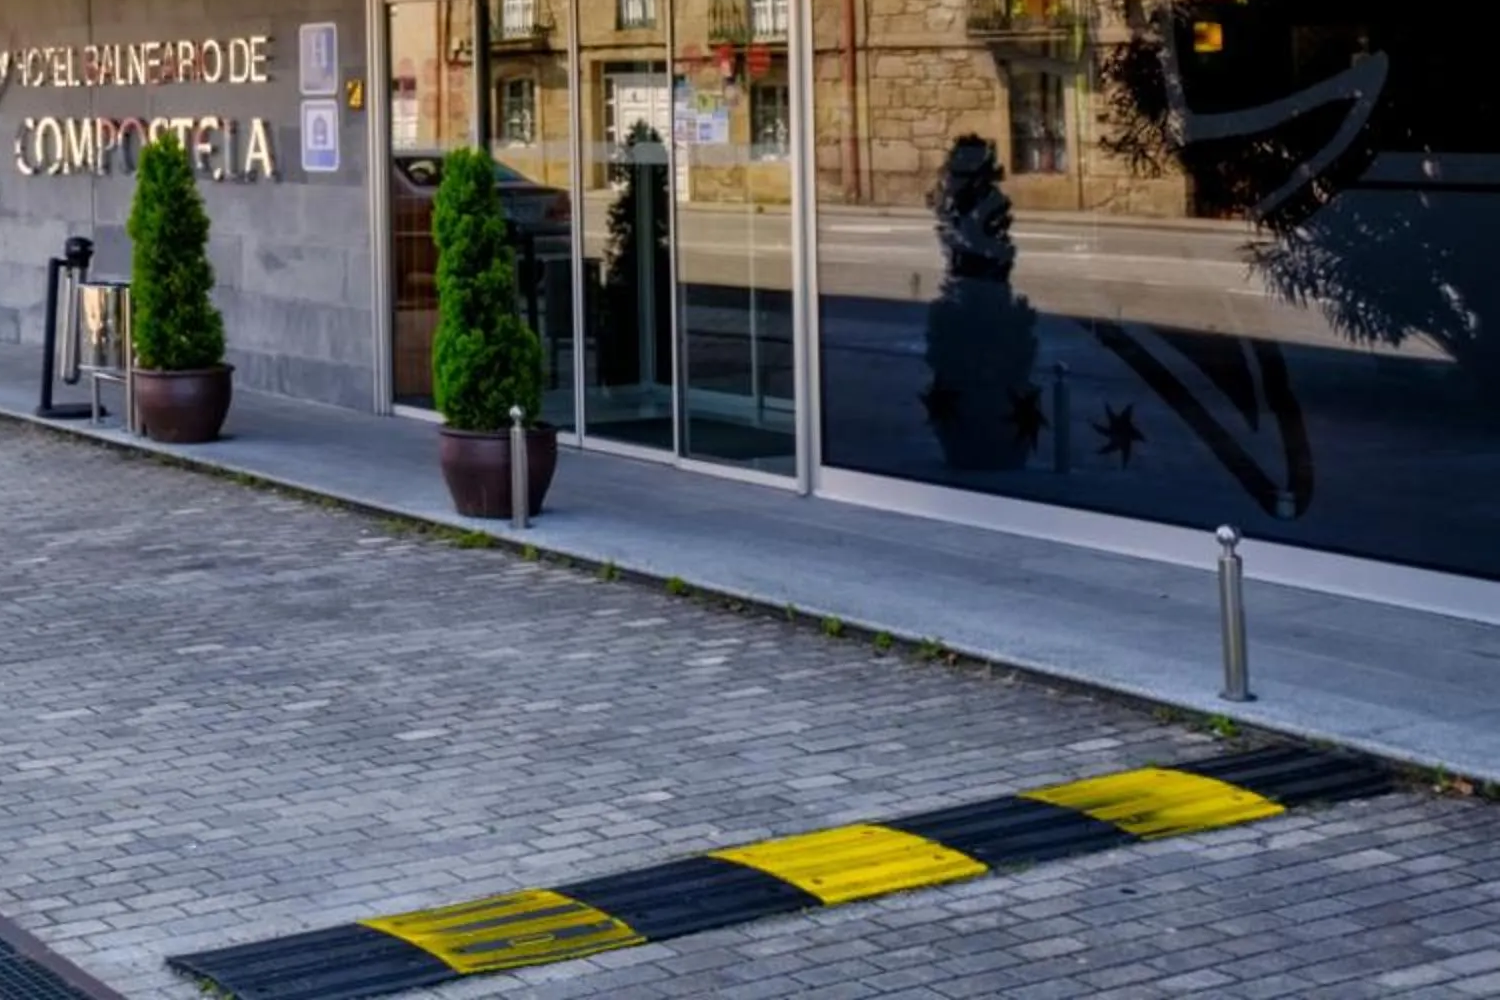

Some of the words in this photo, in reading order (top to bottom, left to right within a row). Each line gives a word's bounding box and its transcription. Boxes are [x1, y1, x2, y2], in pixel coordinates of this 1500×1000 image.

[13, 46, 80, 87] HOTEL
[83, 38, 222, 86] BALNEARIO
[228, 35, 268, 83] DE
